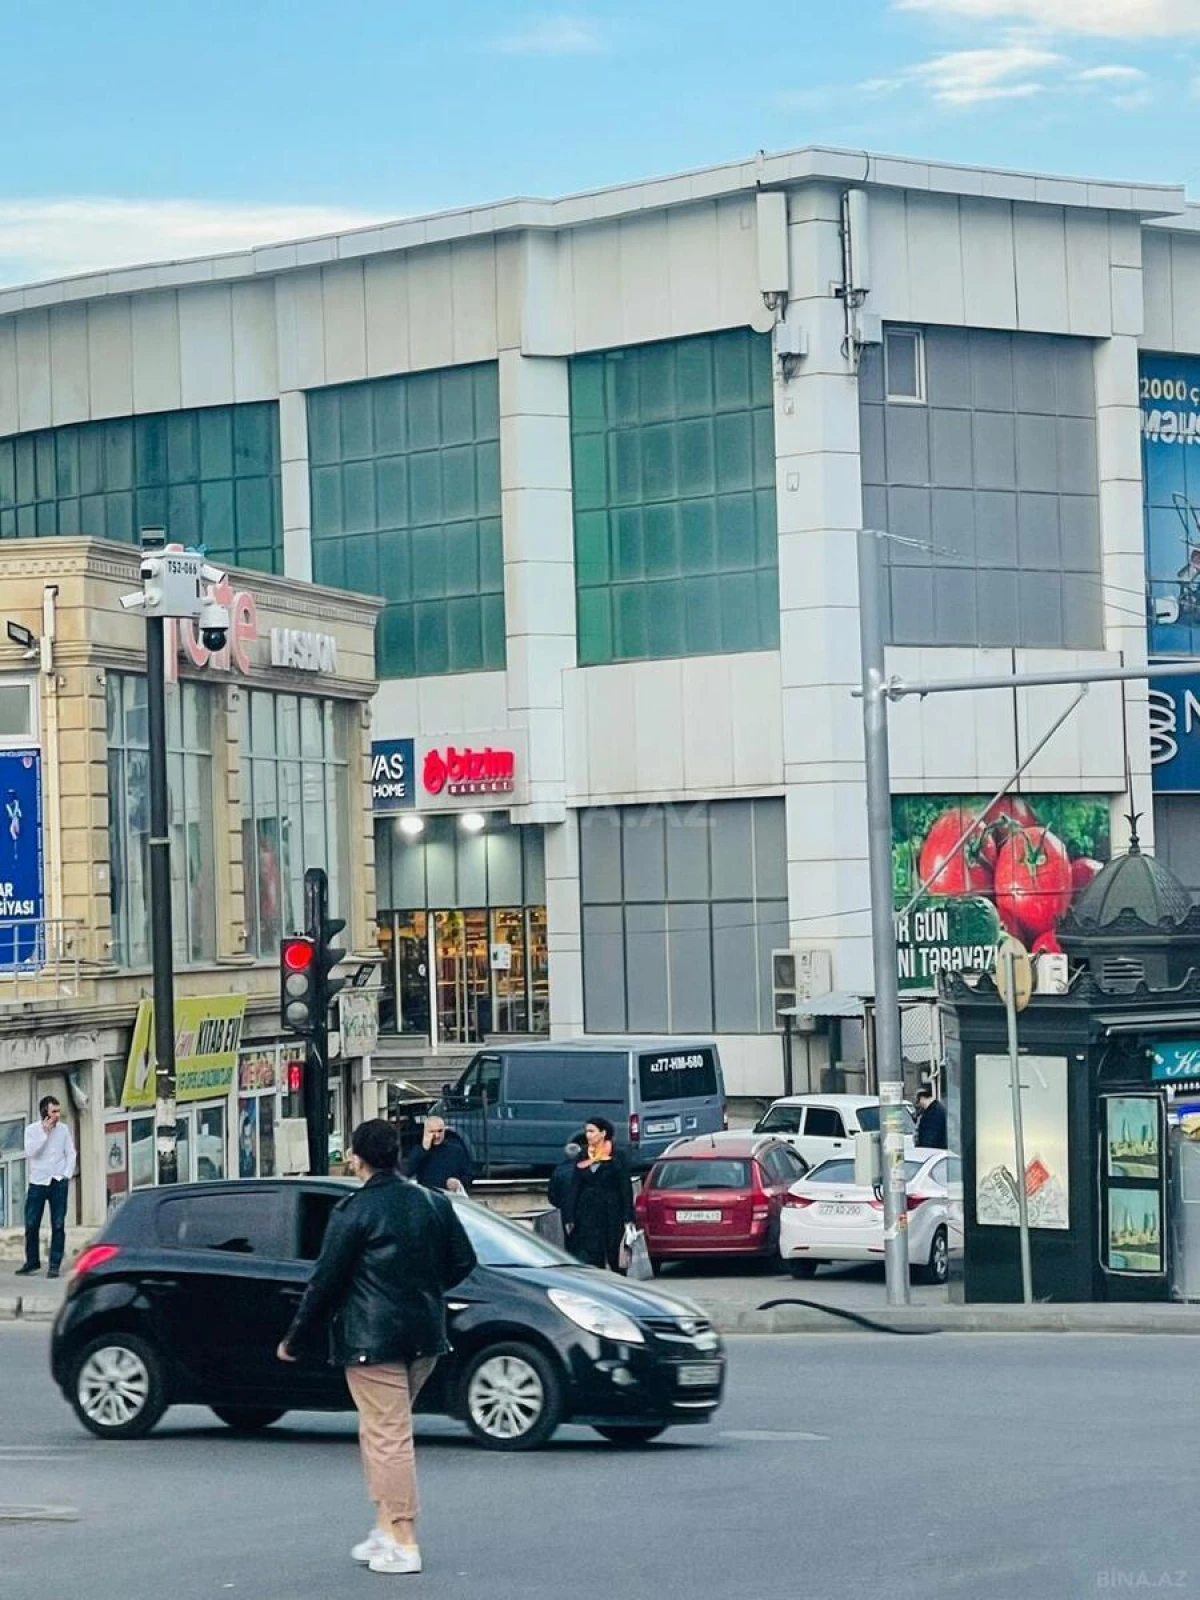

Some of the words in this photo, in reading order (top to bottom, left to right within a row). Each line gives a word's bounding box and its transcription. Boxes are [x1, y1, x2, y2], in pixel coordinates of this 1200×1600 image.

[1140, 377, 1187, 401] 2000
[447, 747, 514, 781] bizim
[372, 783, 405, 798] HOME
[0, 896, 35, 916] İYASI
[915, 907, 949, 942] GÜN
